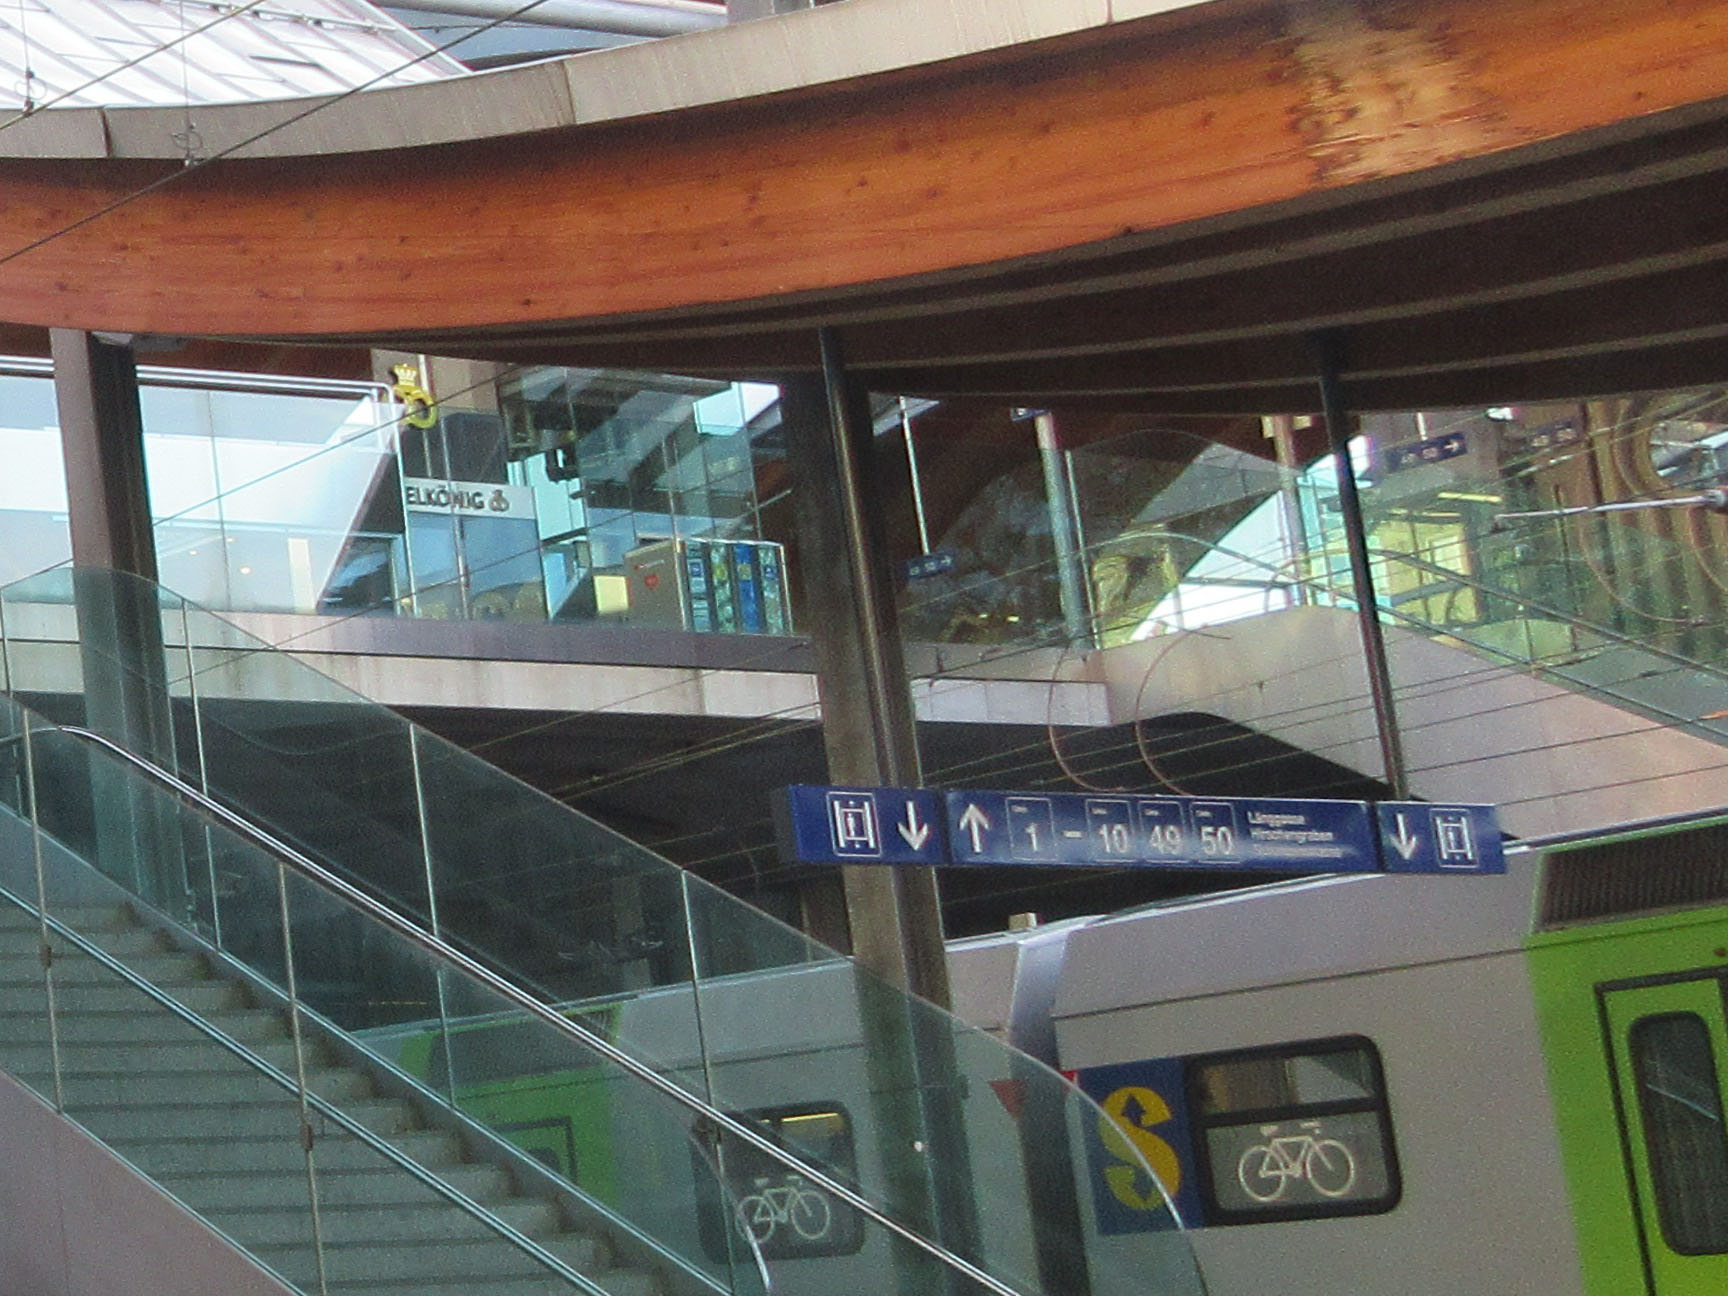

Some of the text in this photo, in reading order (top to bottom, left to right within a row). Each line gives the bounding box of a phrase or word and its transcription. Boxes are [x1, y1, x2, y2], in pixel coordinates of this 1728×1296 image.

[1025, 822, 1039, 852] 1
[1098, 823, 1129, 854] 10
[1149, 824, 1182, 855] 49
[1200, 825, 1234, 856] 50
[1098, 1085, 1182, 1212] S
